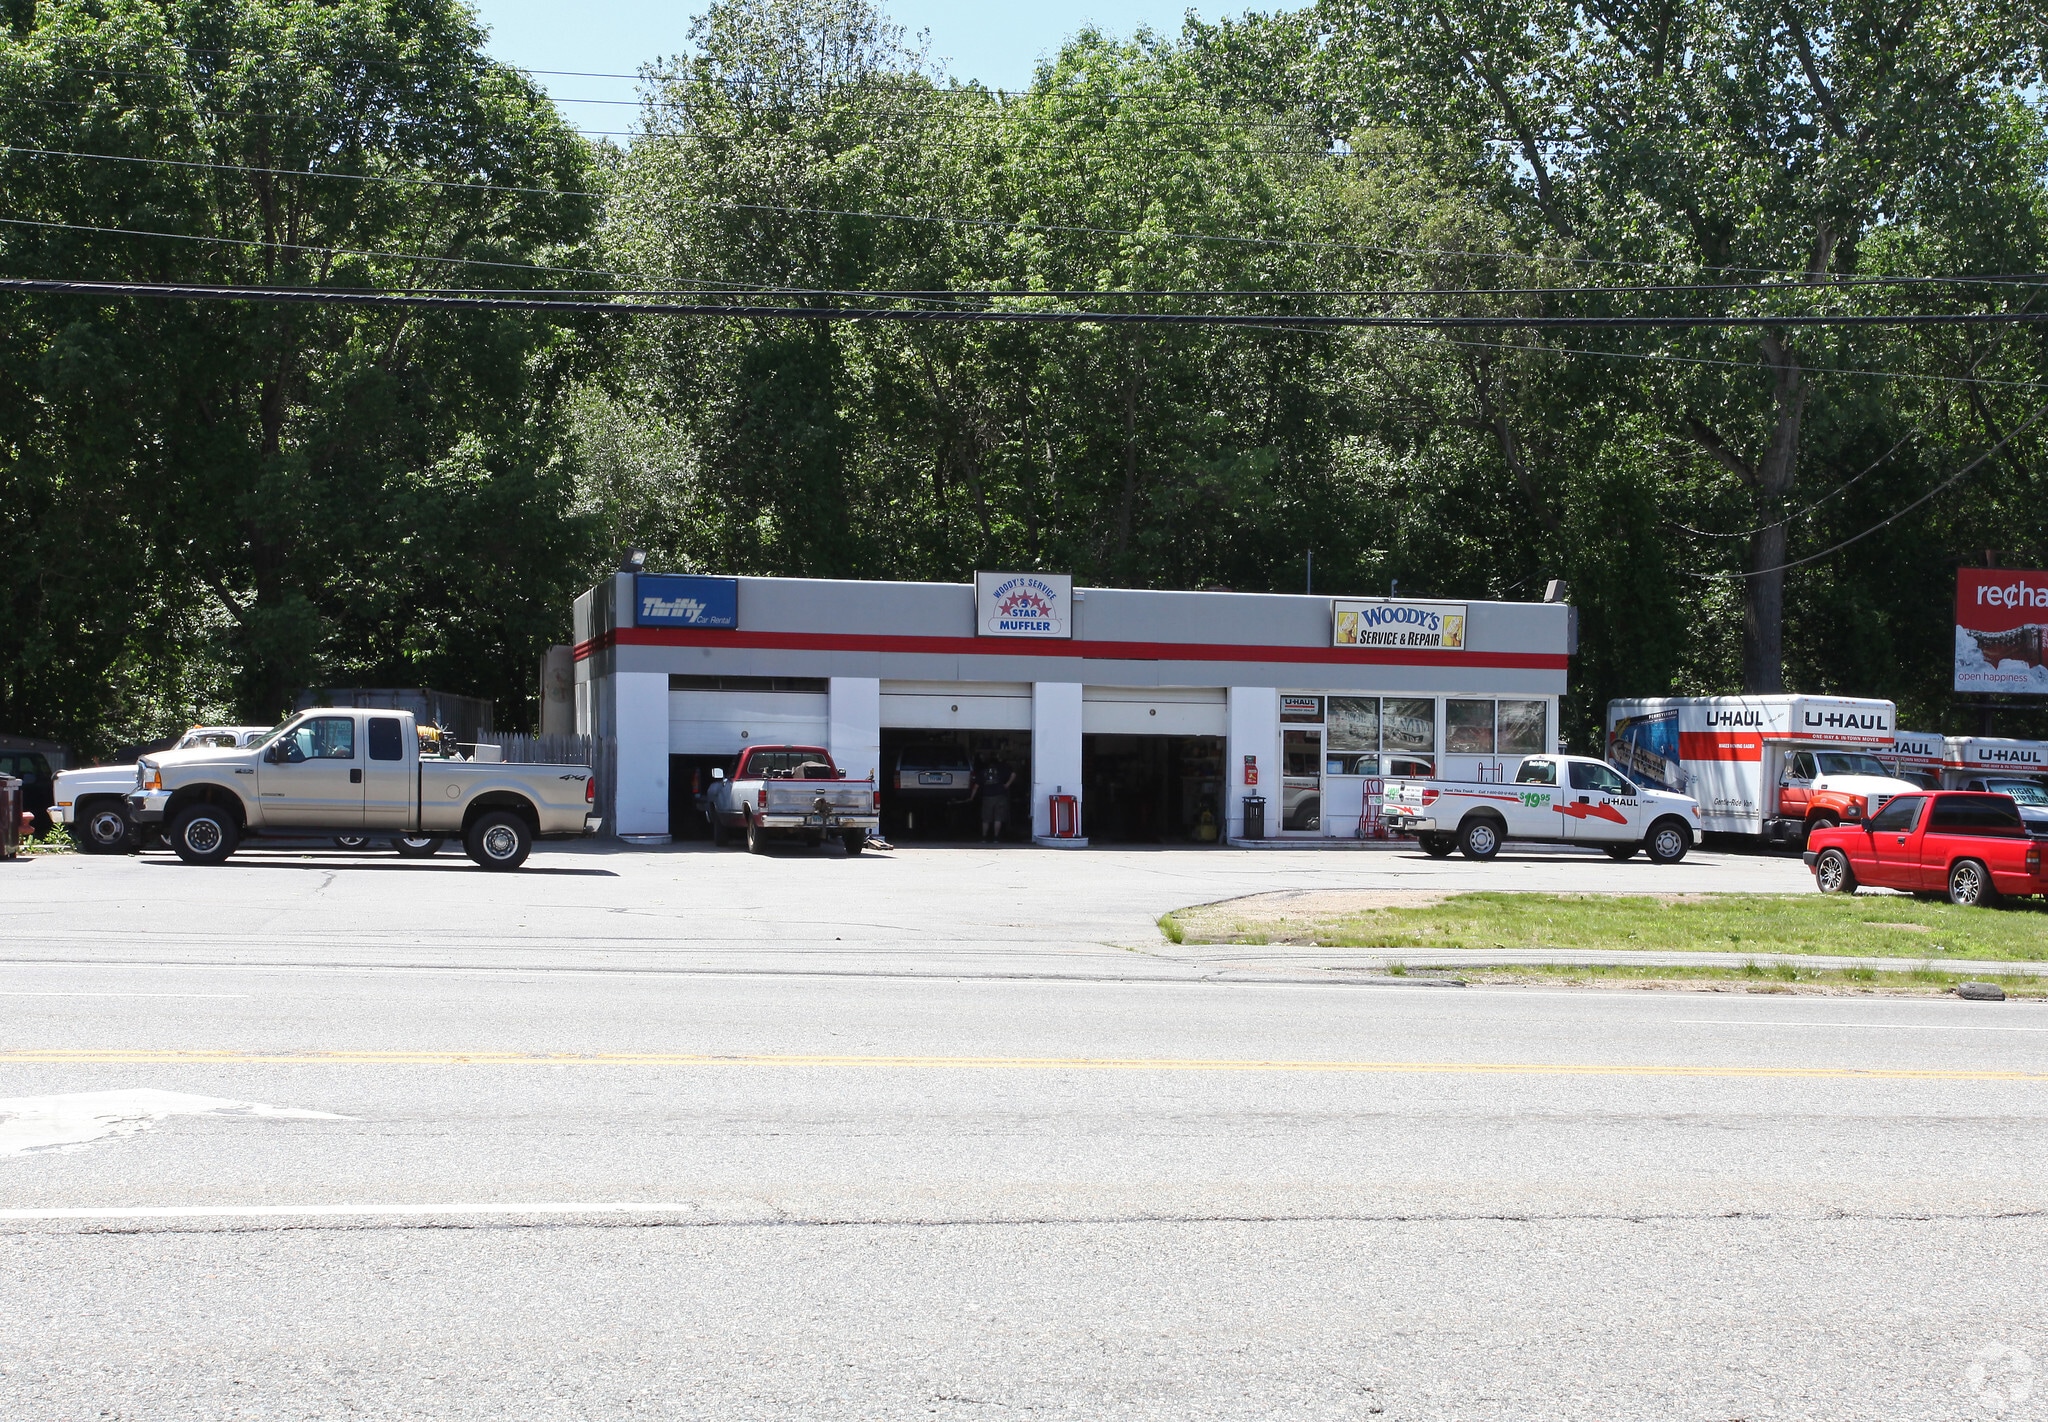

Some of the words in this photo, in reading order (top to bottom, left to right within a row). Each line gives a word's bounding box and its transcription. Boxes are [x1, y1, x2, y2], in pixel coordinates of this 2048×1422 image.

[993, 578, 1025, 599] WOODY'S
[1028, 579, 1057, 601] SERVICE
[642, 597, 707, 623] Thrifty
[1021, 599, 1028, 608] 5
[1012, 608, 1037, 617] STAR
[1361, 606, 1440, 631] WOODY'S
[696, 615, 708, 624] Car
[710, 616, 731, 624] Rental
[1000, 620, 1050, 631] MUFFLER
[1360, 630, 1398, 645] SERVICE
[1400, 634, 1406, 645] &
[1408, 631, 1440, 646] REPAIR
[1959, 672, 1981, 682] open
[1983, 672, 2028, 682] happiness
[1706, 711, 1763, 726] U-HAUL
[1805, 711, 1888, 731] U-HAUL
[1979, 749, 2041, 762] U-HAUL
[1602, 797, 1639, 806] U-HAUL
